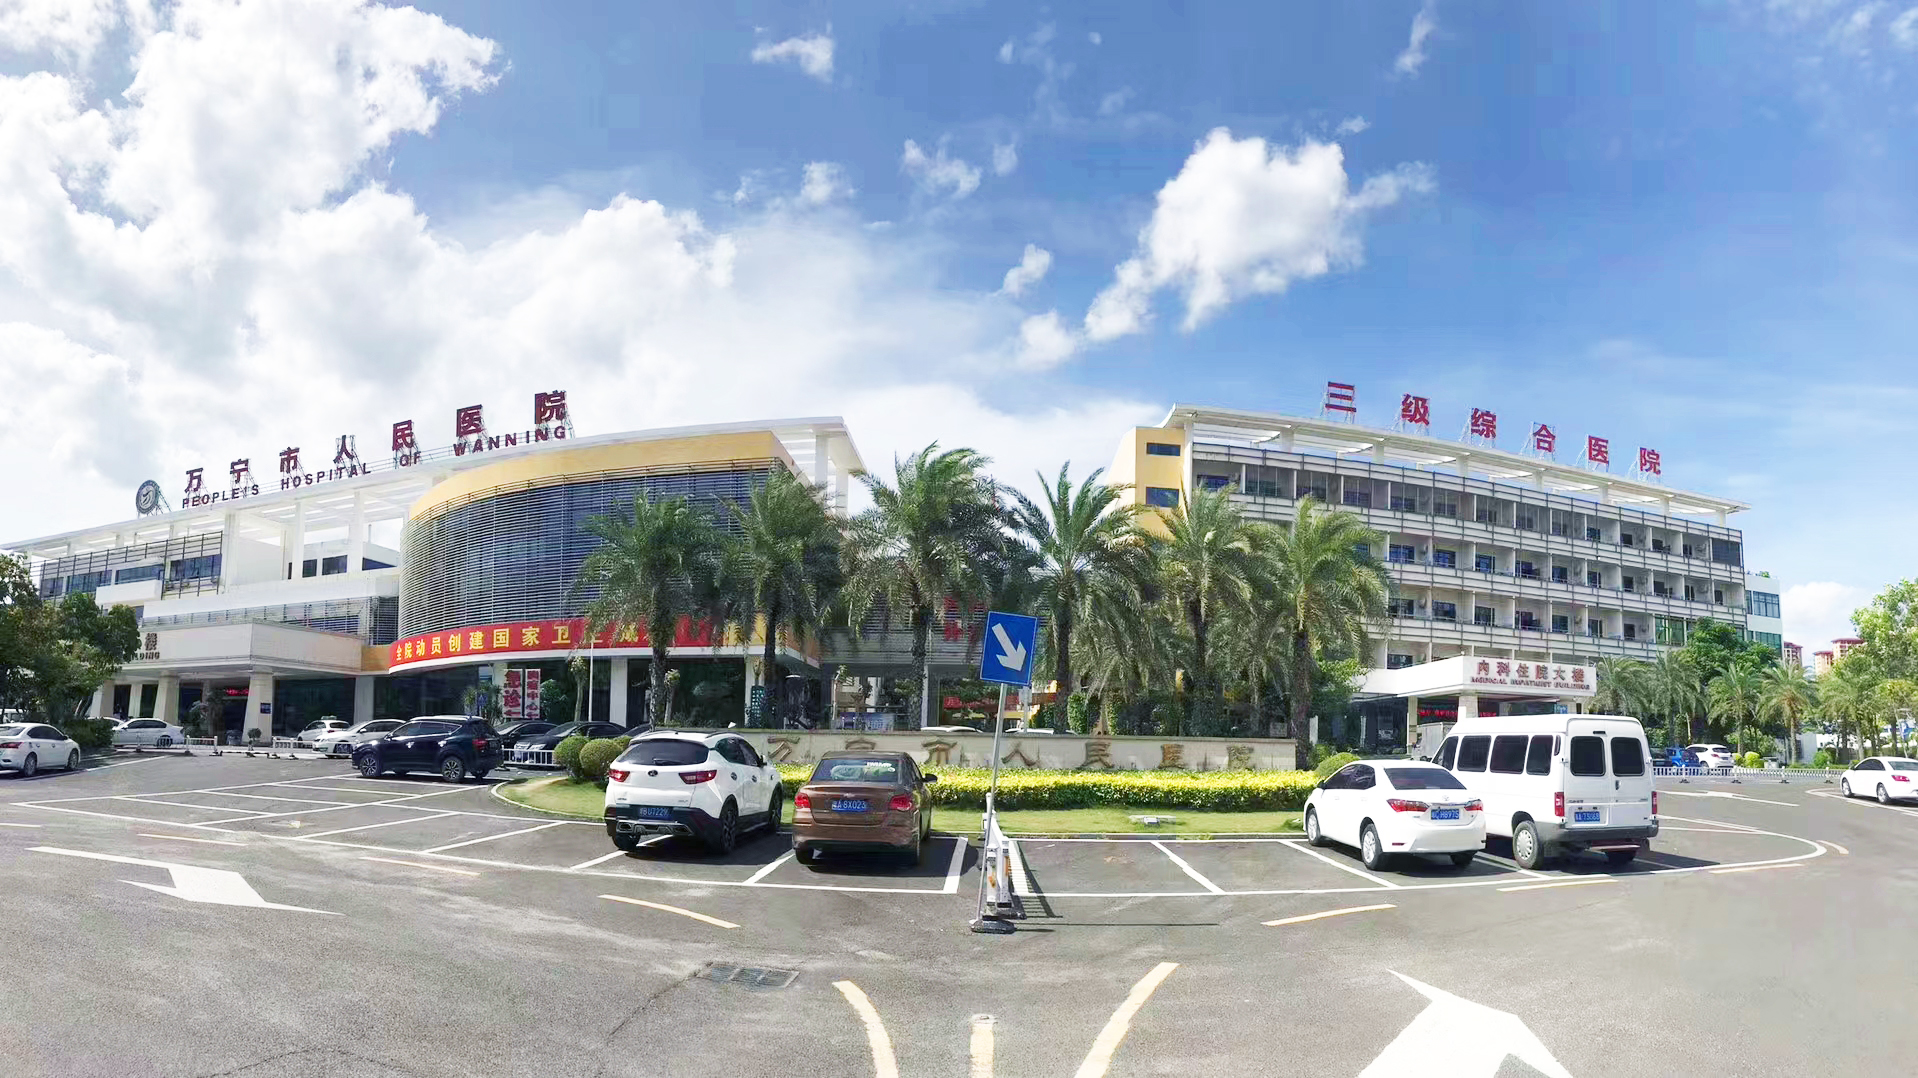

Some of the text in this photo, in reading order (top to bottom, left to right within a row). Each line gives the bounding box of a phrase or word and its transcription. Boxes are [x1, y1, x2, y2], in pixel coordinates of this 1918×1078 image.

[185, 390, 567, 493] 万宁市人民医院
[281, 463, 371, 490] HOSPITAL
[400, 451, 421, 467] OF
[453, 426, 566, 457] WANNING
[1325, 381, 1662, 475] 三级综合医院
[1477, 660, 1585, 683] 内科住院大楼
